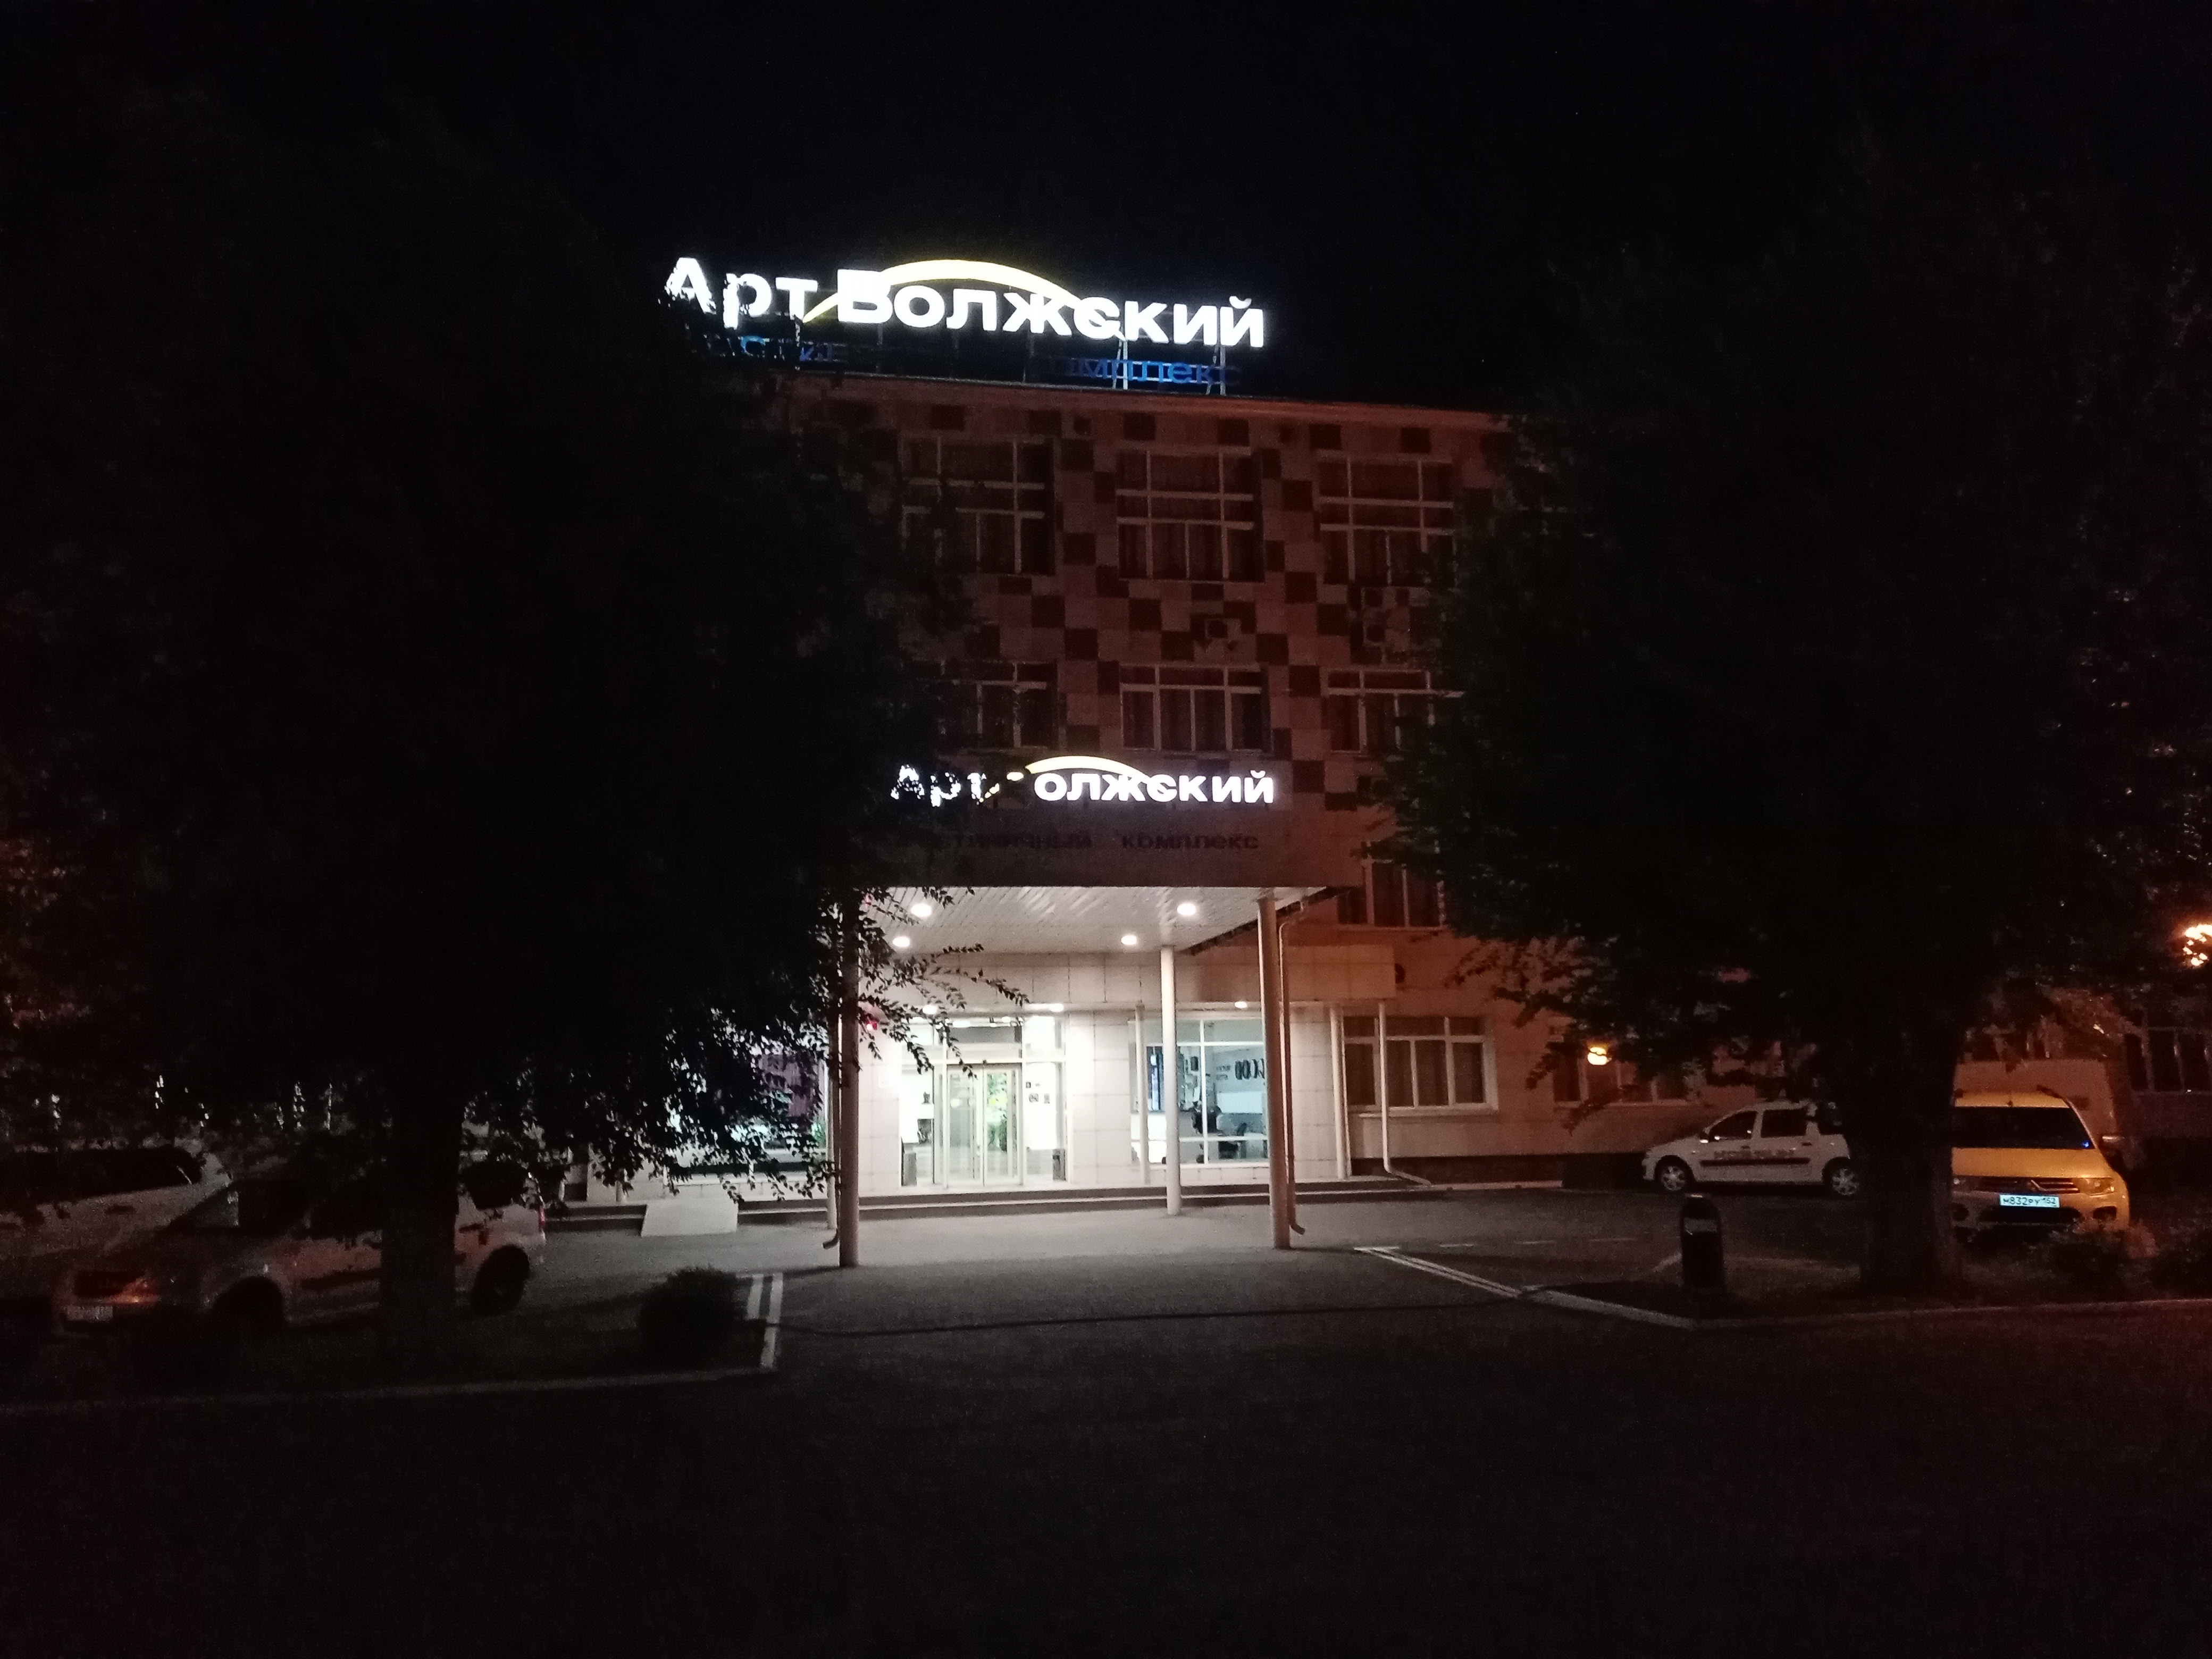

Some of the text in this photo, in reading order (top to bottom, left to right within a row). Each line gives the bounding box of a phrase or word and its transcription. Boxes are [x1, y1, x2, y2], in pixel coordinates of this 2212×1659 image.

[663, 256, 1266, 347] Арт Волжский
[1007, 769, 1275, 804] олжский
[1121, 834, 1259, 850] комплекс
